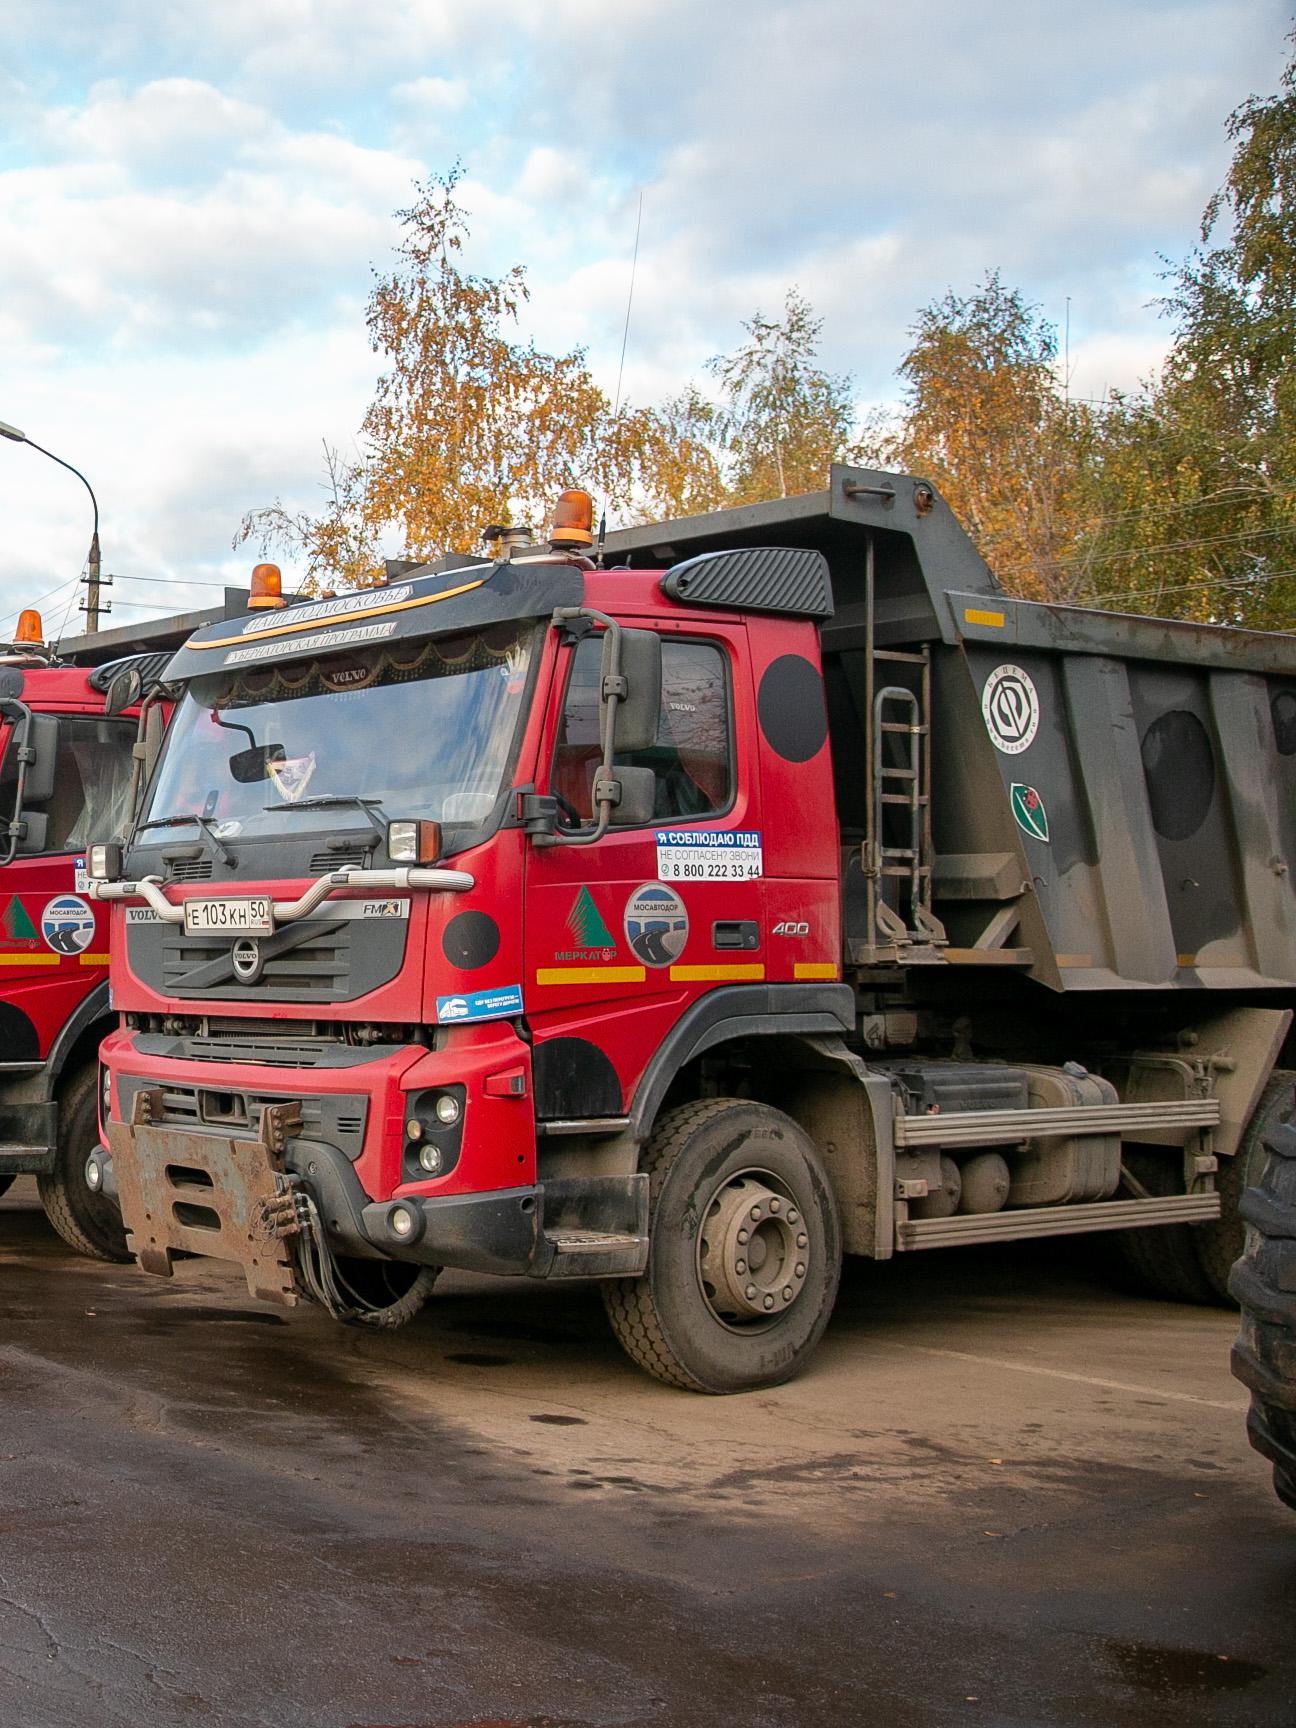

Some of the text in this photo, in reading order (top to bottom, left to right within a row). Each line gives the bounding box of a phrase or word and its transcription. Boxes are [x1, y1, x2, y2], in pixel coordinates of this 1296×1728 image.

[319, 623, 394, 645] ПРОГРАММА
[331, 668, 366, 683] VOLVO
[657, 833, 759, 847] Я СОБЛЮДАЮ ПДД
[660, 850, 760, 861] НЕ СОГЛАСЕН? ЗВОНИ
[76, 859, 84, 867] Я
[673, 864, 760, 877] 8 800 222 33 44
[250, 901, 265, 918] 50
[633, 903, 679, 912] МОСАВТОДОР
[129, 909, 164, 920] VOLV
[772, 922, 809, 936] 400
[233, 952, 257, 960] VOLVO
